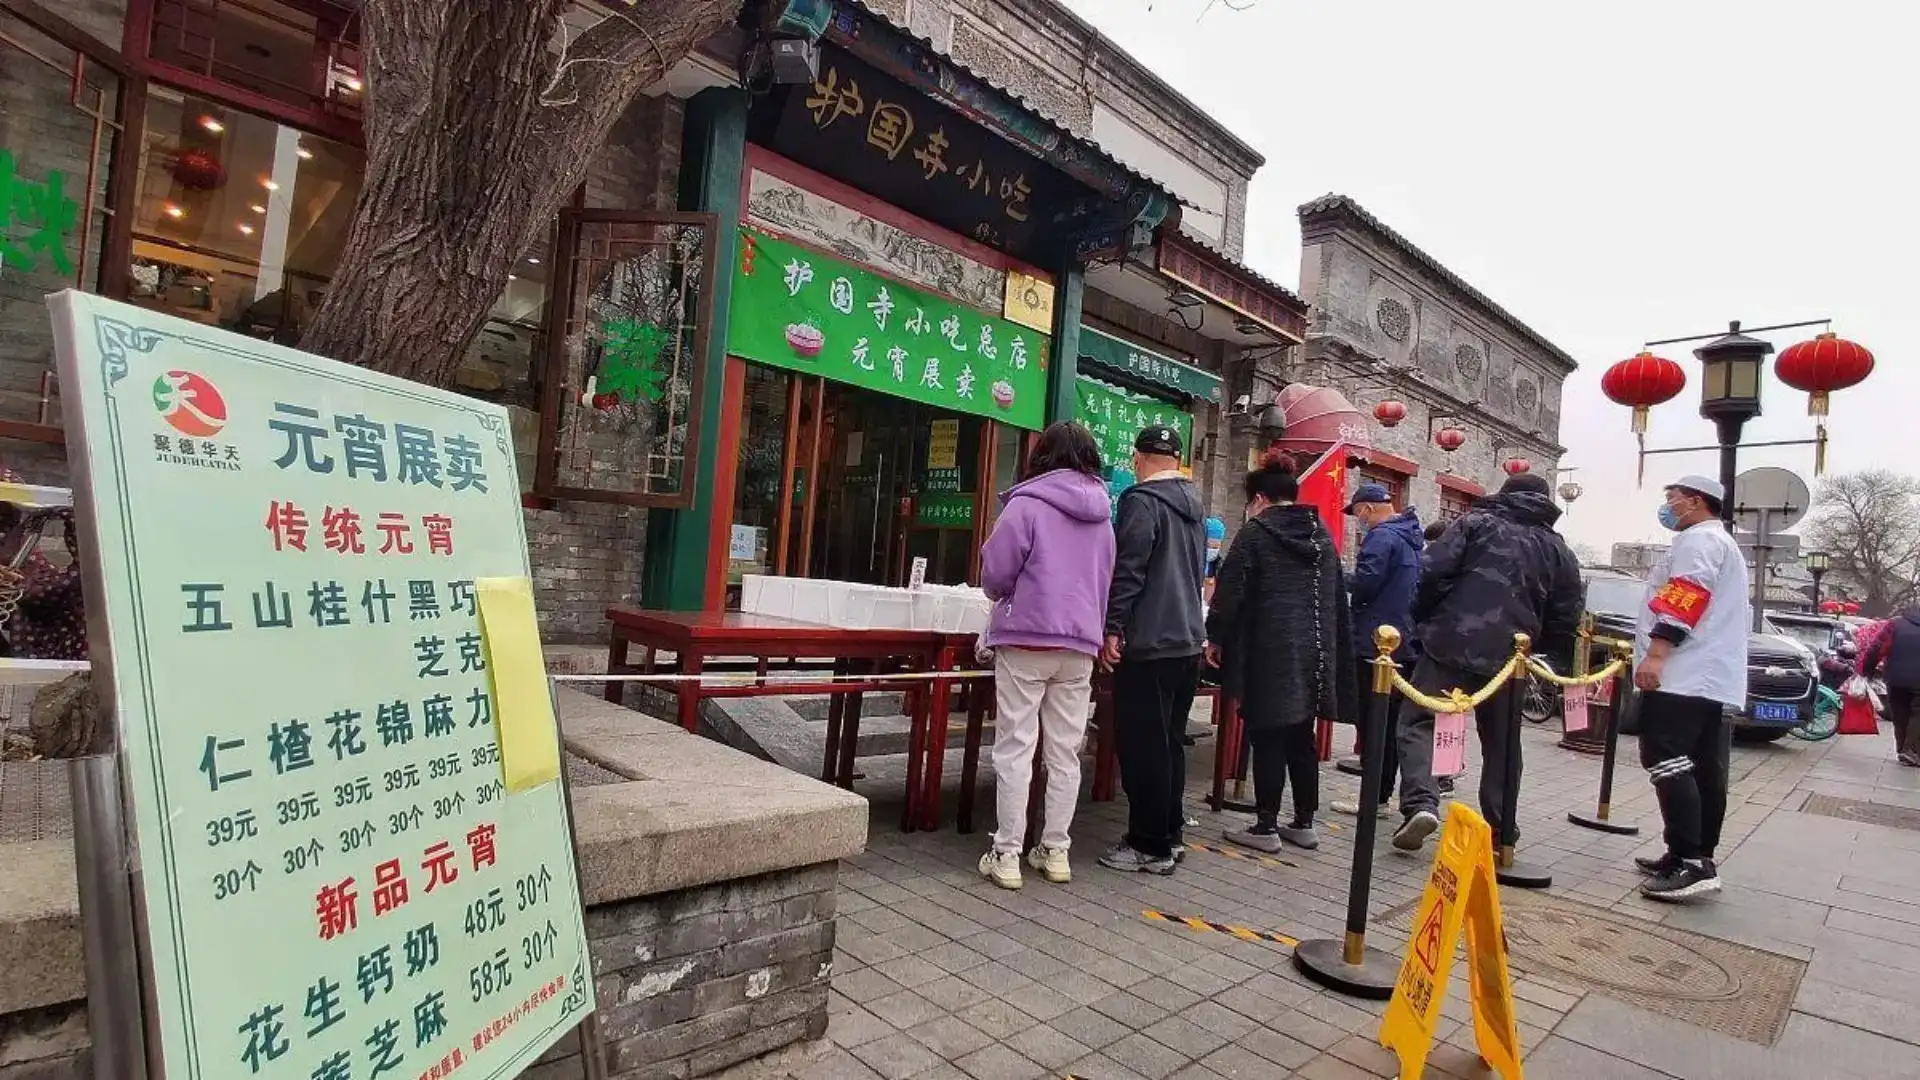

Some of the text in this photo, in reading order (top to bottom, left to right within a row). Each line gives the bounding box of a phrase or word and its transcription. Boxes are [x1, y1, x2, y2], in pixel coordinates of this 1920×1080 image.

[806, 66, 1032, 222] 护国寺小吃
[784, 257, 1029, 371] 护国寺小吃总店
[850, 336, 978, 401] 元宵展卖
[153, 433, 239, 460] 聚德华天
[156, 453, 241, 471] JUDEHUATIAN
[268, 400, 490, 494] 元宵展卖
[265, 500, 456, 556] 传统元宵
[415, 631, 486, 678] 芝克
[199, 687, 492, 793] 仁楂花锦麻力
[205, 741, 501, 847] 39元 39元 39元 39元 39元 39元
[213, 778, 505, 901] 30个 30个 30个 30个 30个 30个
[315, 822, 499, 942] 新品元宵
[237, 863, 553, 1076] 花生钙奶 48元 30个
[469, 948, 513, 1003] 58元
[522, 919, 558, 970] 30个
